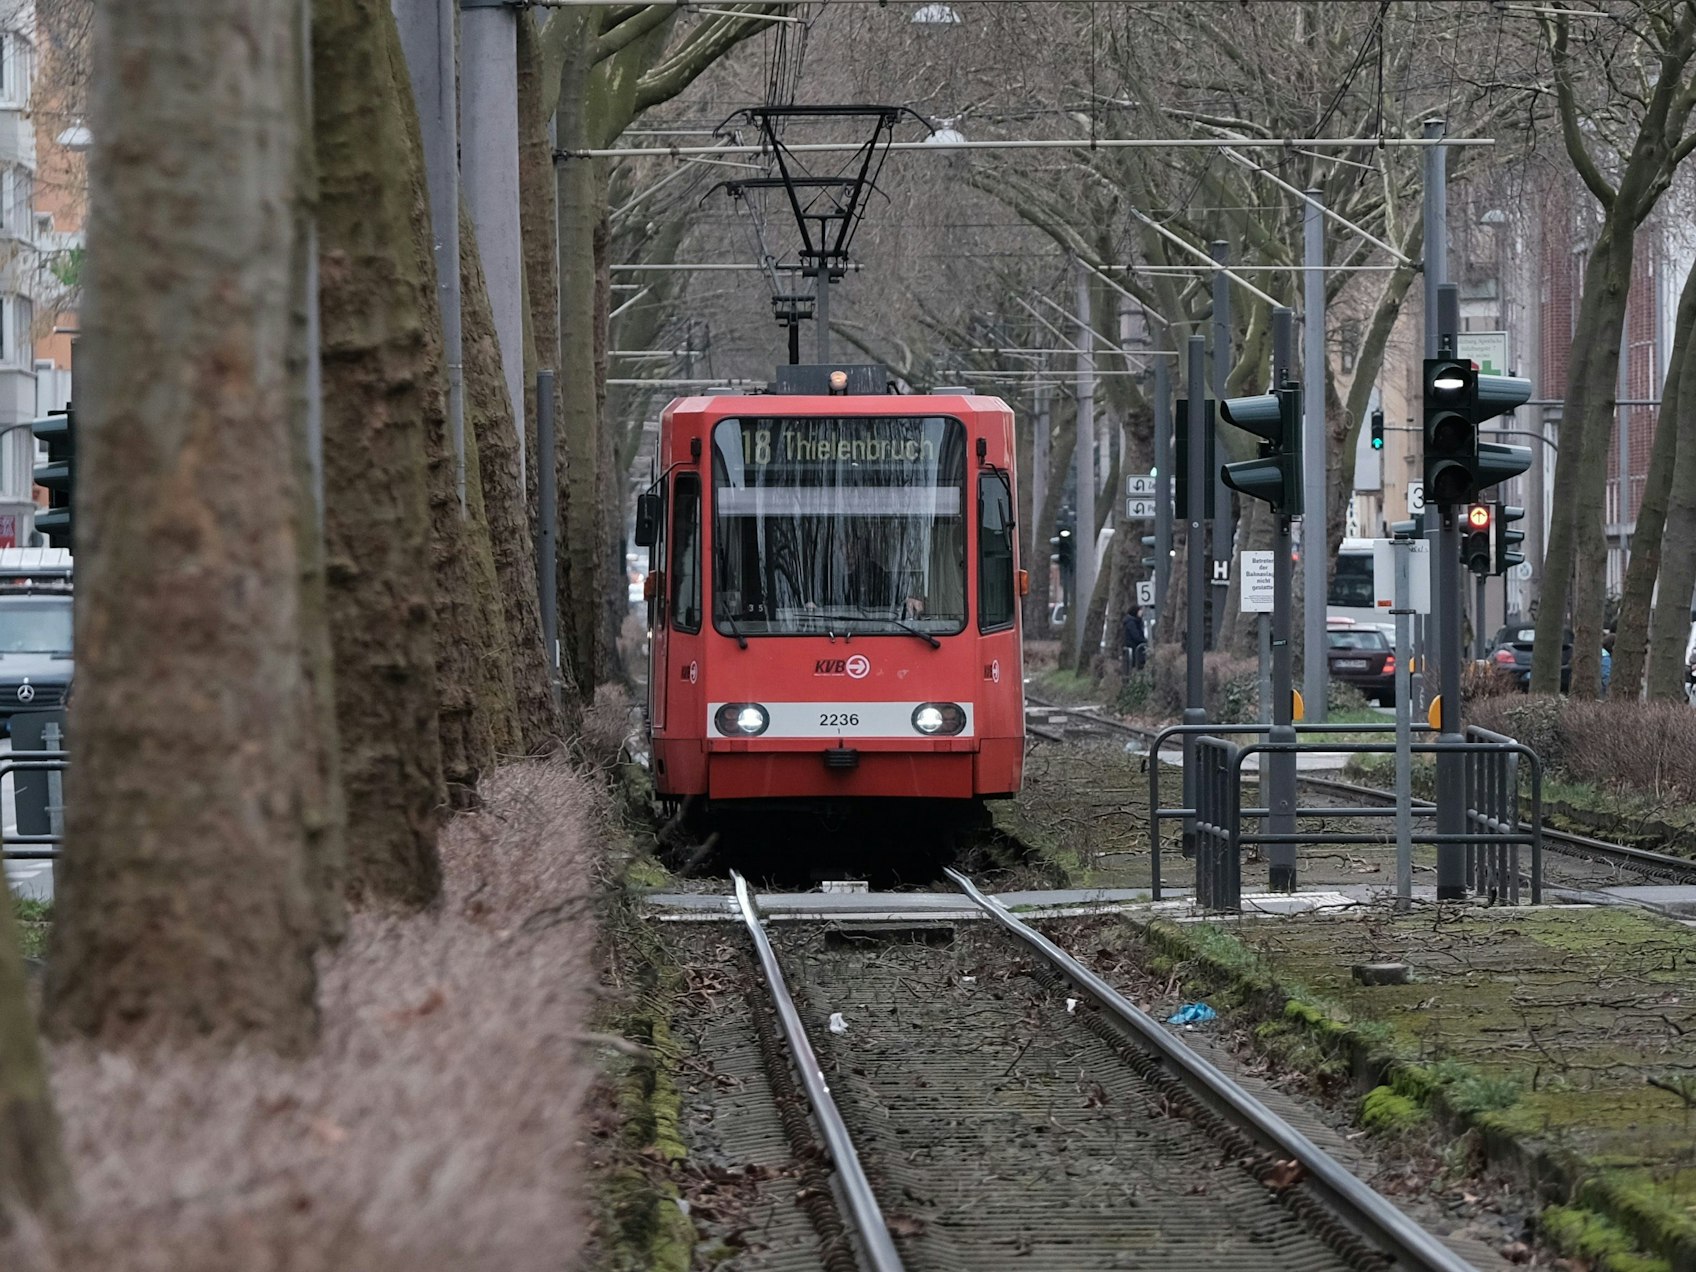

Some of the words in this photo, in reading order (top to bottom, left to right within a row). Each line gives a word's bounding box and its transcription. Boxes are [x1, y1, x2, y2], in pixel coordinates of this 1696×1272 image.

[742, 430, 771, 464] 18
[784, 431, 934, 461] Thielenbruch
[1413, 487, 1424, 509] 3
[1214, 560, 1228, 579] H
[1141, 585, 1151, 602] 5
[815, 660, 846, 673] KVB
[819, 713, 860, 726] 2236
